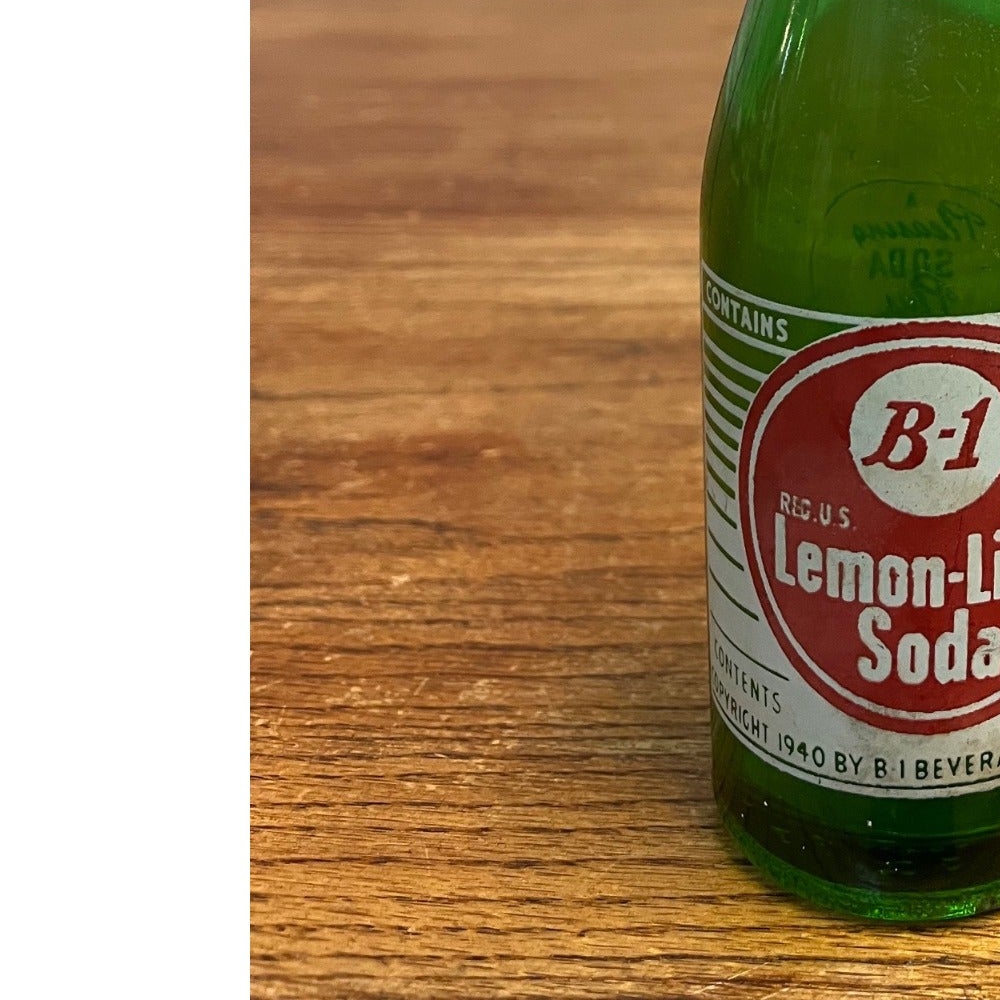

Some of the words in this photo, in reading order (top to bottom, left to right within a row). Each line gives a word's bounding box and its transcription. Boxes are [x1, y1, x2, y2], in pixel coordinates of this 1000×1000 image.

[706, 280, 789, 343] CONTAINS
[861, 397, 991, 471] B-1
[713, 638, 781, 714] CONTENTS
[778, 732, 825, 768] 1940
[834, 750, 863, 776] BY
